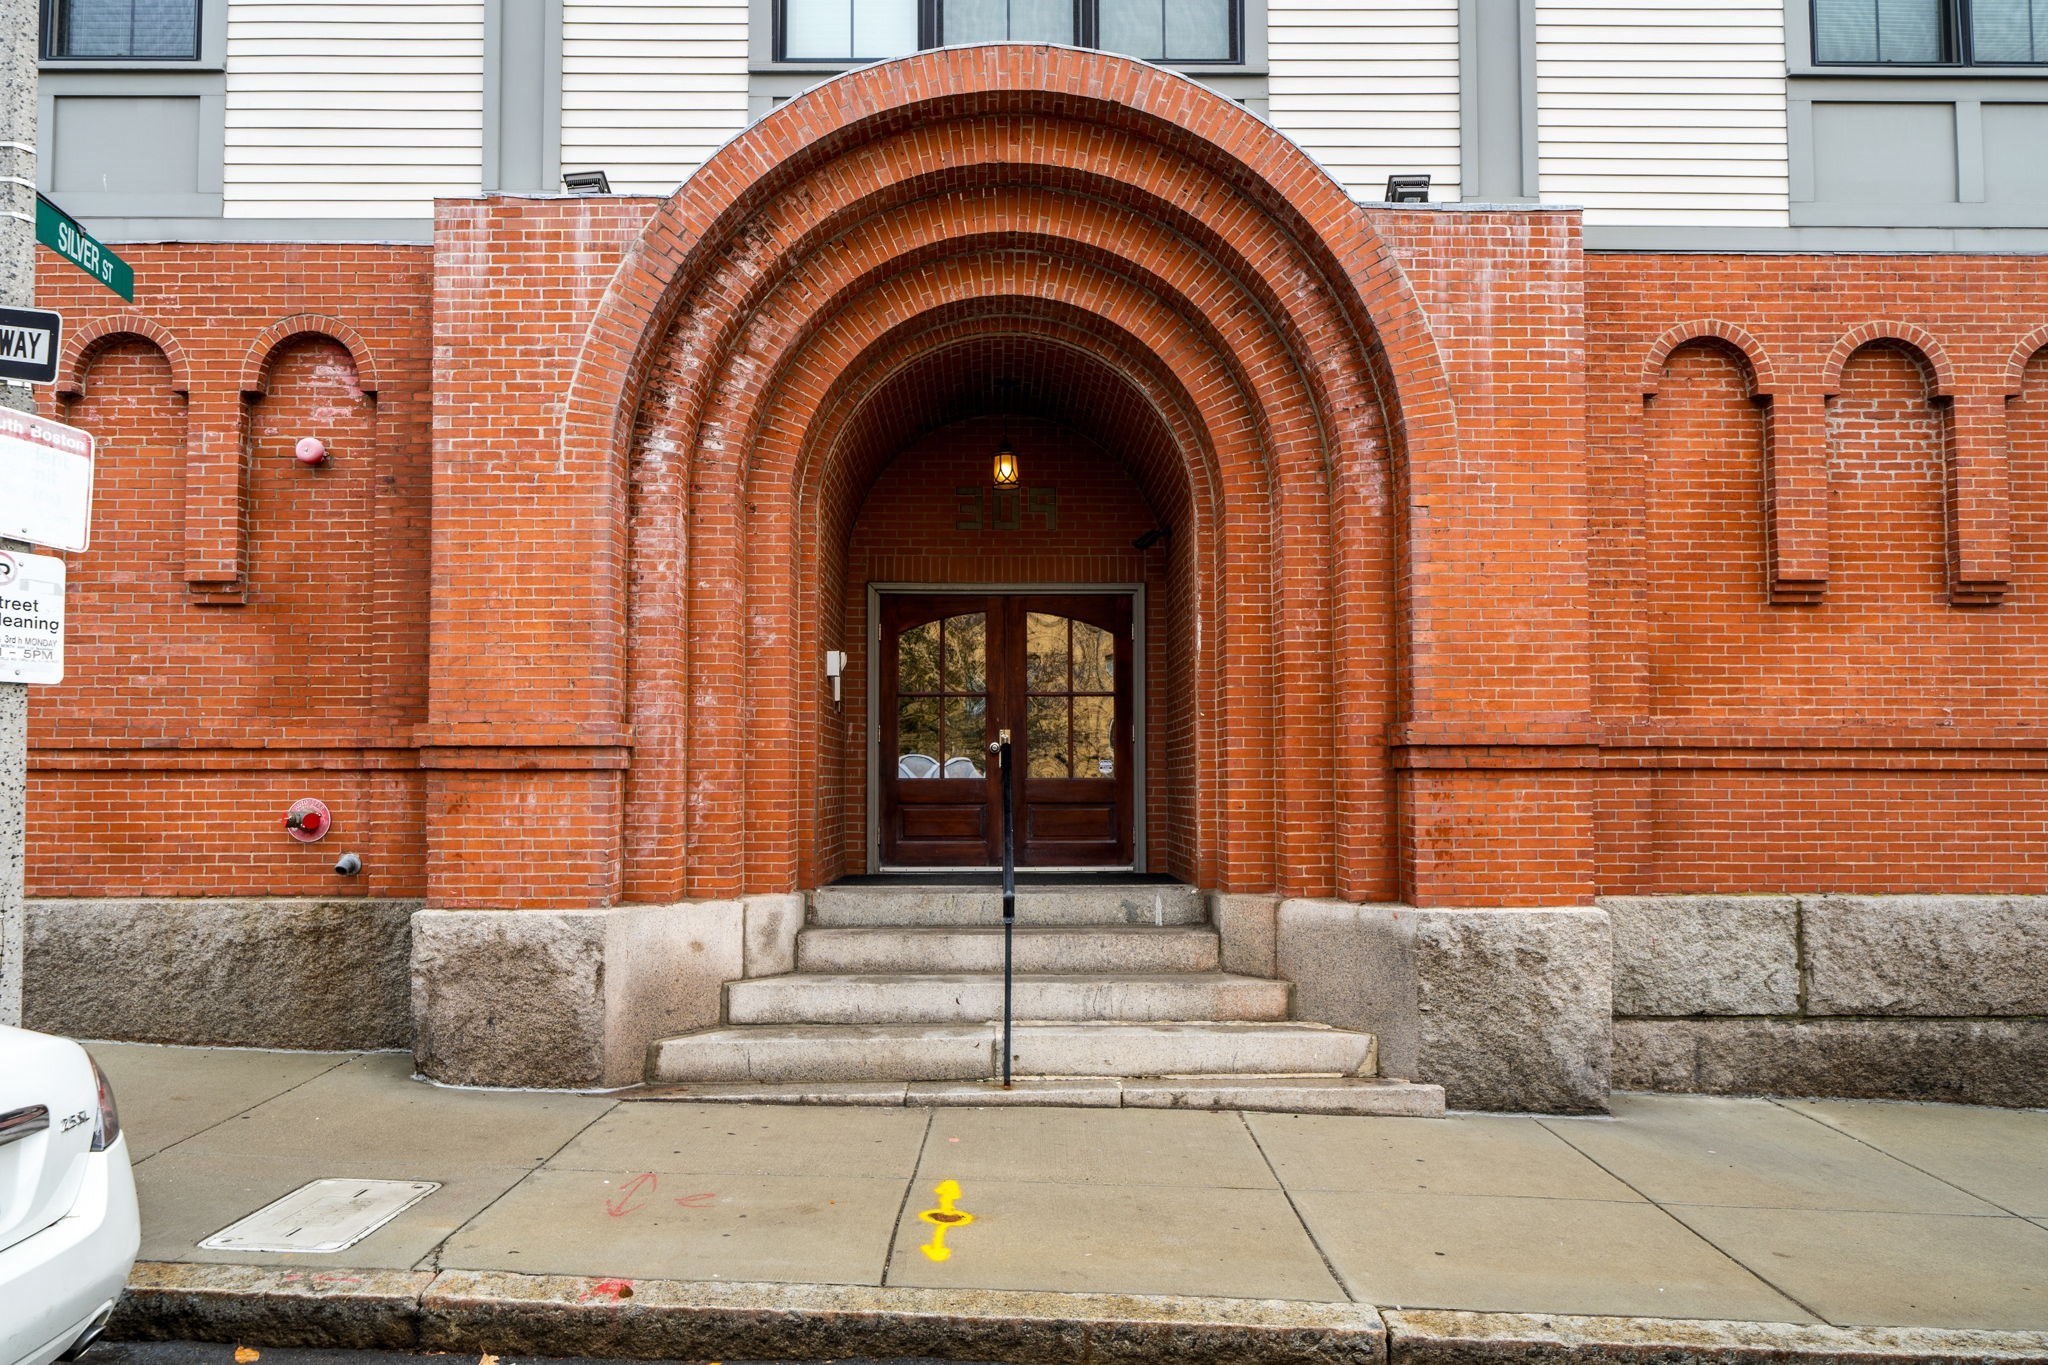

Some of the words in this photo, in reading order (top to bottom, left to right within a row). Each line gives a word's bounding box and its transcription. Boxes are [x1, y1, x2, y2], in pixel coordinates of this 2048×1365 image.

[58, 222, 100, 274] SILVER
[102, 259, 114, 284] ST
[0, 328, 42, 359] WAY
[0, 418, 23, 434] uth
[30, 424, 86, 451] Boston
[955, 487, 1057, 530] 309
[0, 595, 39, 612] treet
[0, 612, 59, 634] leaning
[4, 635, 16, 644] 3rd
[25, 637, 57, 647] MONDAY
[23, 649, 53, 660] 5PM
